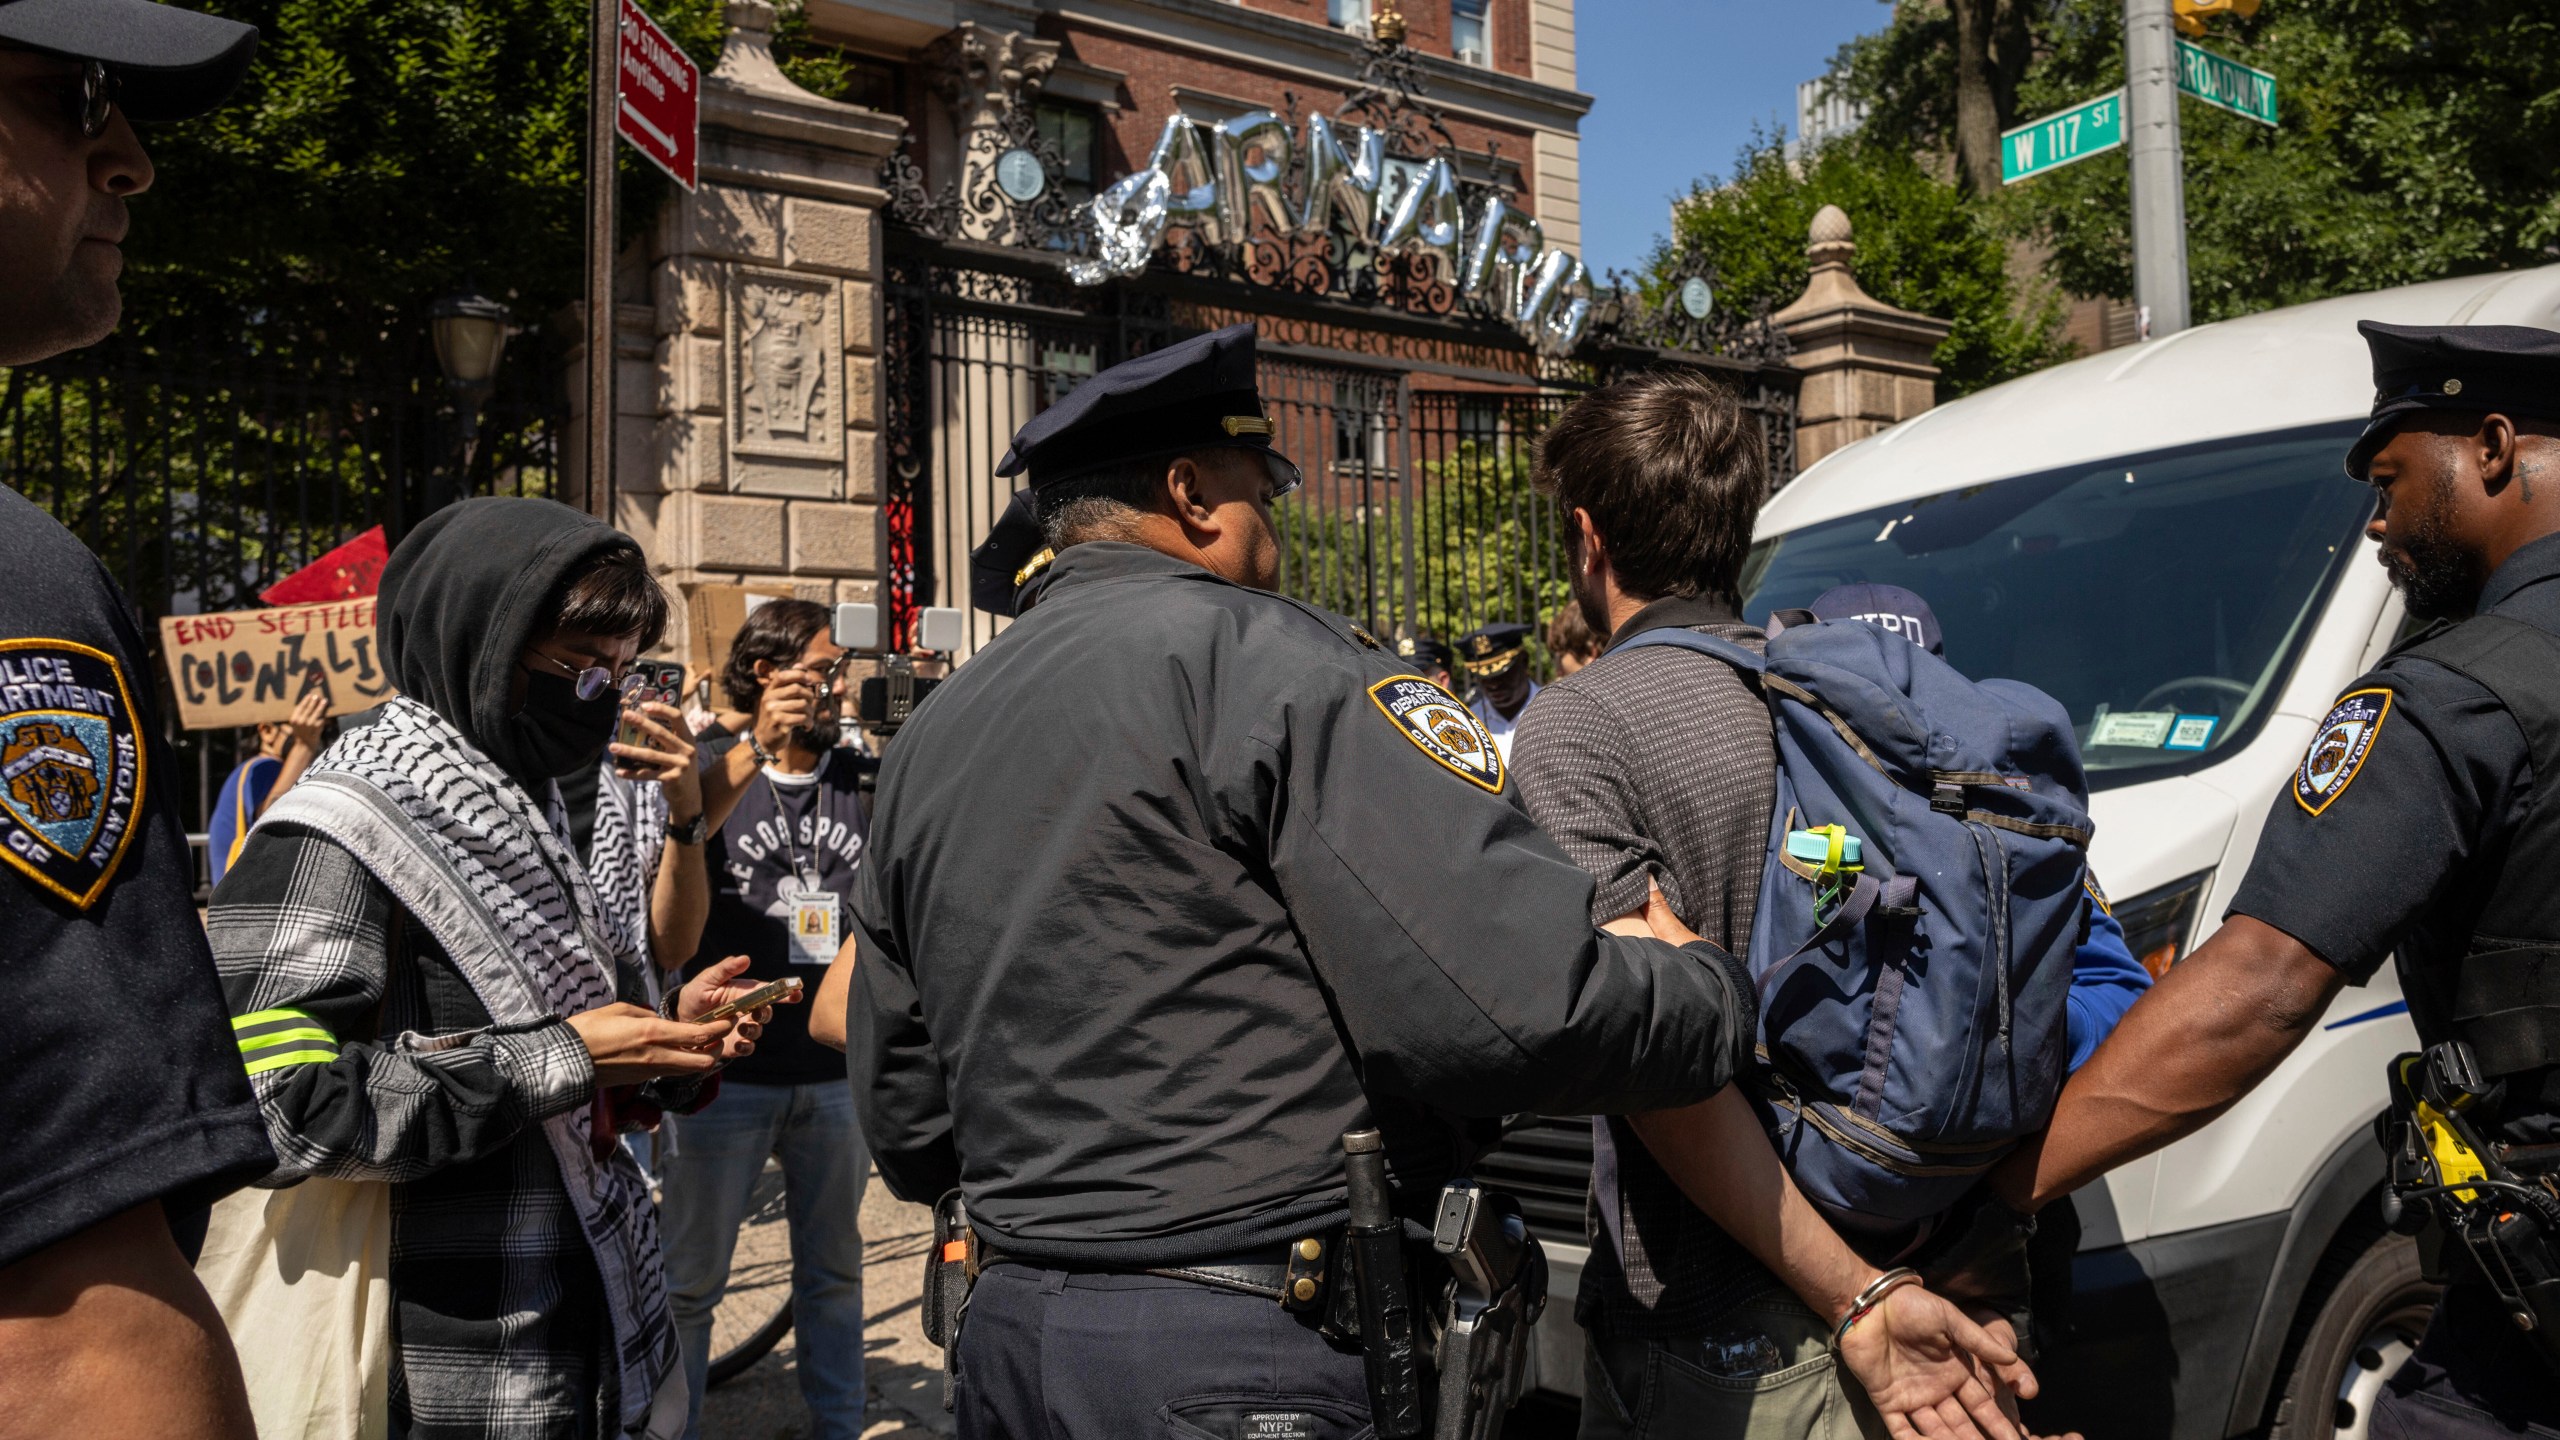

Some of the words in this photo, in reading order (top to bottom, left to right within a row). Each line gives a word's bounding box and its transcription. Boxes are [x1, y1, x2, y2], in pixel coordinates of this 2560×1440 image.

[623, 12, 639, 46] NO
[640, 30, 689, 93] STANDING
[622, 46, 665, 102] Anytime
[2014, 131, 2035, 172] W
[2048, 114, 2082, 161] 117
[2092, 103, 2111, 127] ST
[174, 614, 236, 646] END
[257, 600, 377, 635] SETTLE
[1390, 692, 1463, 717] DEPARTMENT
[1394, 682, 1441, 698] POLICE
[1411, 729, 1448, 757] CITY
[1449, 756, 1472, 773] OF
[1470, 718, 1493, 749] YORK
[1487, 749, 1498, 775] NEW
[2326, 765, 2351, 796] NEW
[2347, 727, 2374, 765] YORK
[88, 808, 127, 869] NEW
[111, 732, 136, 804] YORK
[8, 829, 52, 864] OF
[1252, 1413, 1289, 1421] APPROVED
[1259, 1421, 1293, 1432] NYPD
[1247, 1432, 1280, 1440] EQUIPMENT
[1281, 1431, 1306, 1439] SECTION
